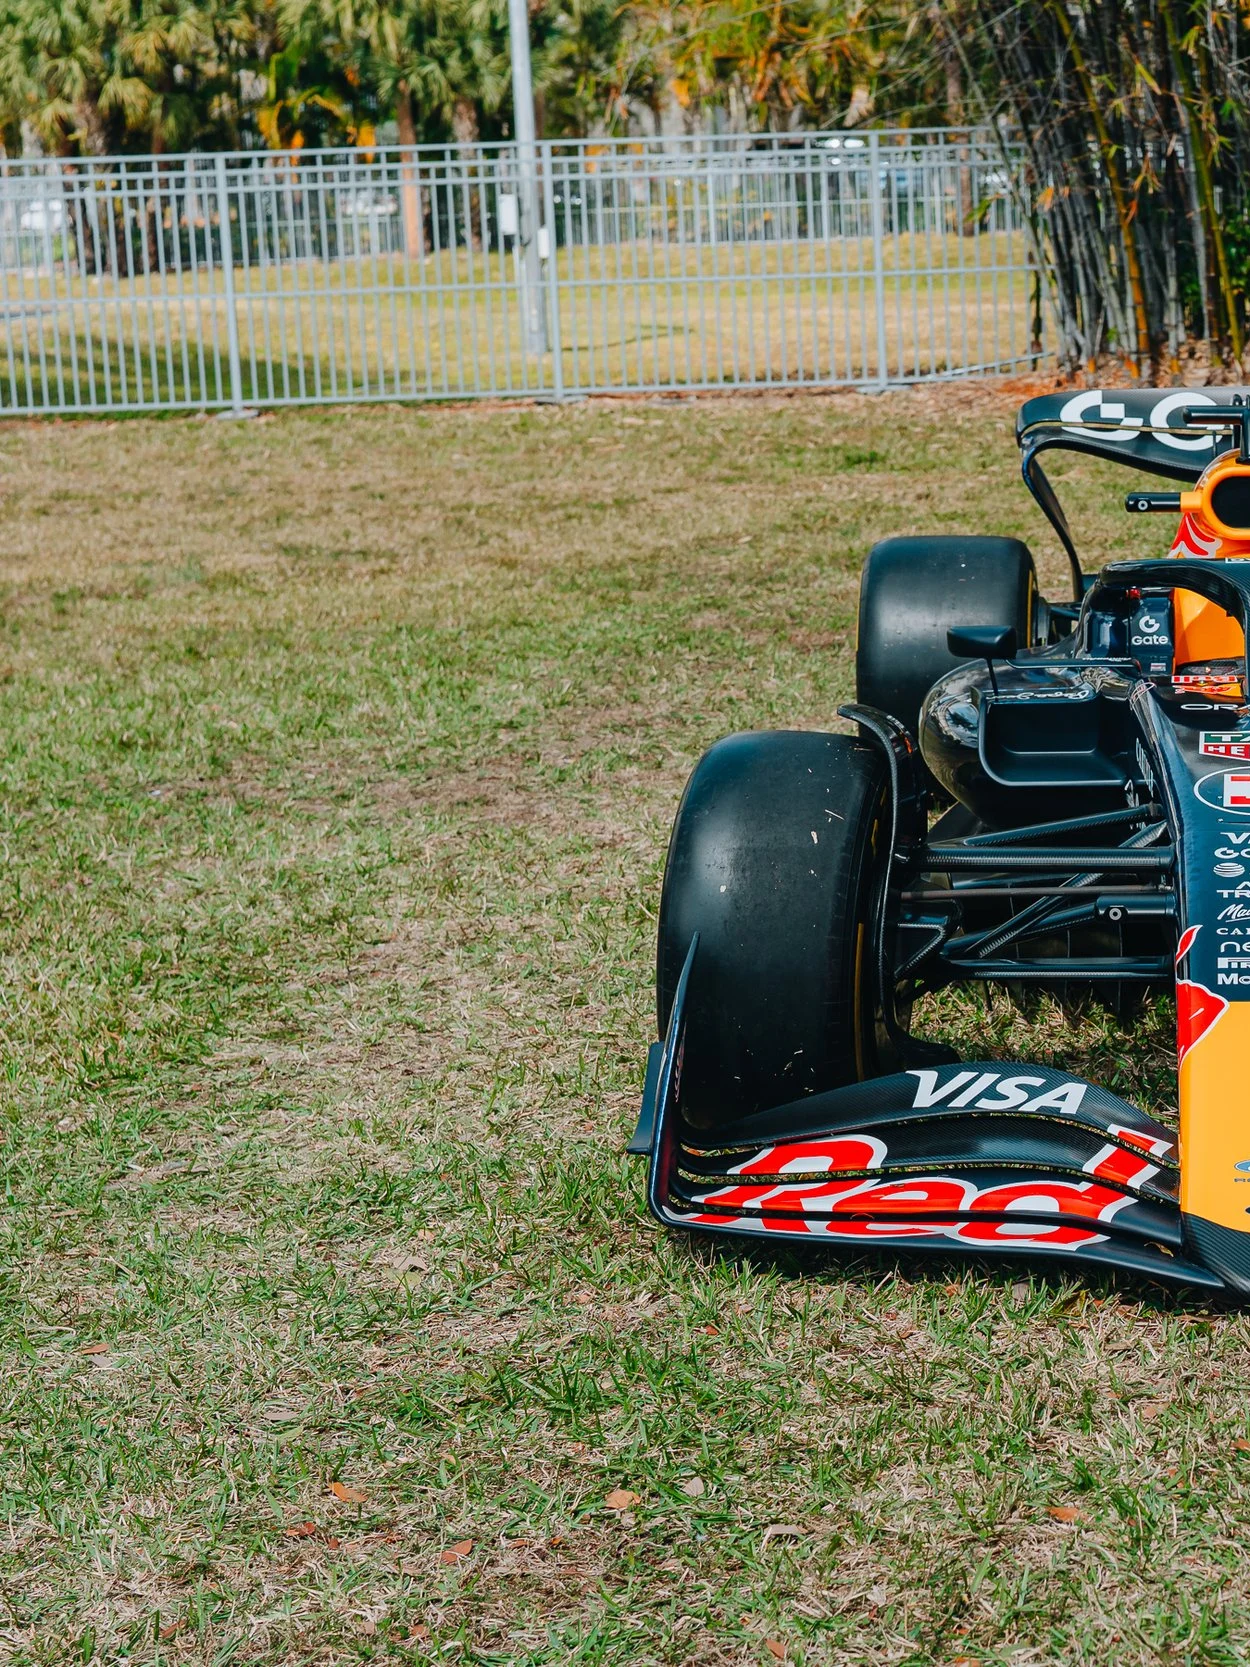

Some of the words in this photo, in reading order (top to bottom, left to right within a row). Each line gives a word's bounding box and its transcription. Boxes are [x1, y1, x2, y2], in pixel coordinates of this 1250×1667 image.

[1131, 635, 1168, 645] Gate
[906, 1070, 1087, 1114] VISA
[664, 1124, 1173, 1250] Red
